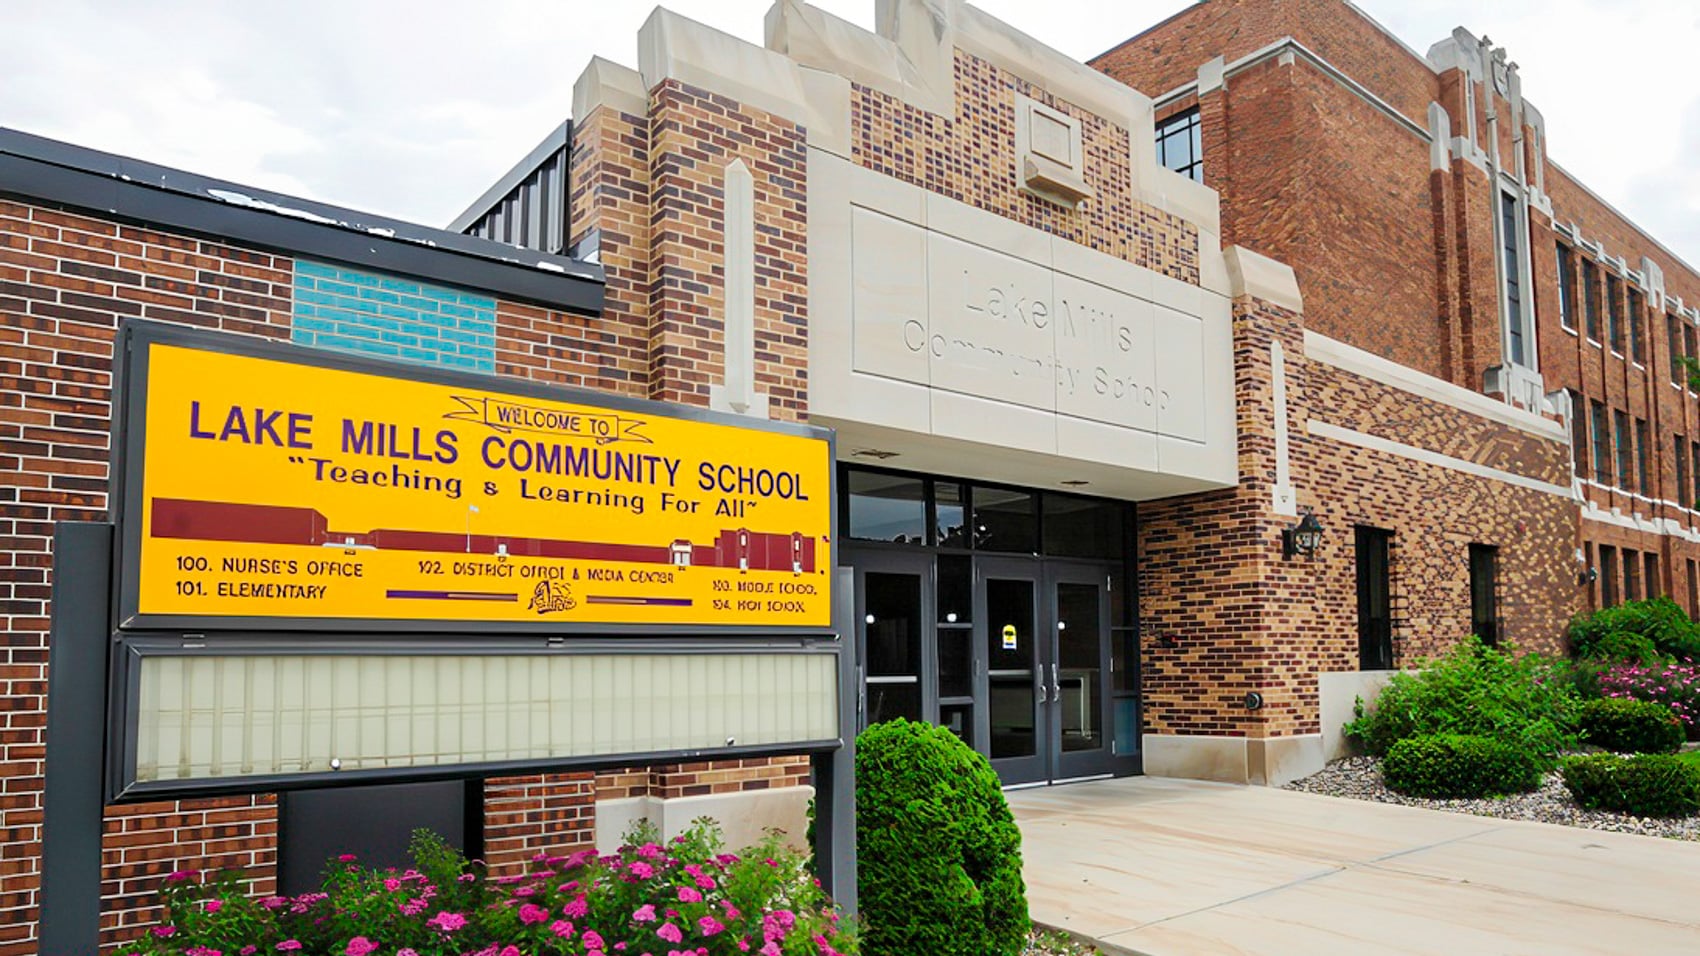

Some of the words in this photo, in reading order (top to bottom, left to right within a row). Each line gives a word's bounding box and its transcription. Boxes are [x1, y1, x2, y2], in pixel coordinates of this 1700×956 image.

[496, 406, 581, 432] WELCOME
[589, 418, 609, 436] TO
[189, 400, 313, 449] LAKE
[341, 418, 459, 465] MILLS
[481, 435, 681, 487] COMMUNITY
[698, 462, 809, 501] SCHOOL
[484, 481, 499, 496] &
[520, 478, 645, 515] Learning
[661, 492, 700, 514] For
[176, 556, 213, 572] 100.
[222, 557, 298, 574] NURSE'S
[307, 560, 363, 577] OFFICE
[176, 580, 208, 597] 101.
[217, 582, 327, 599] ELEMENTARY
